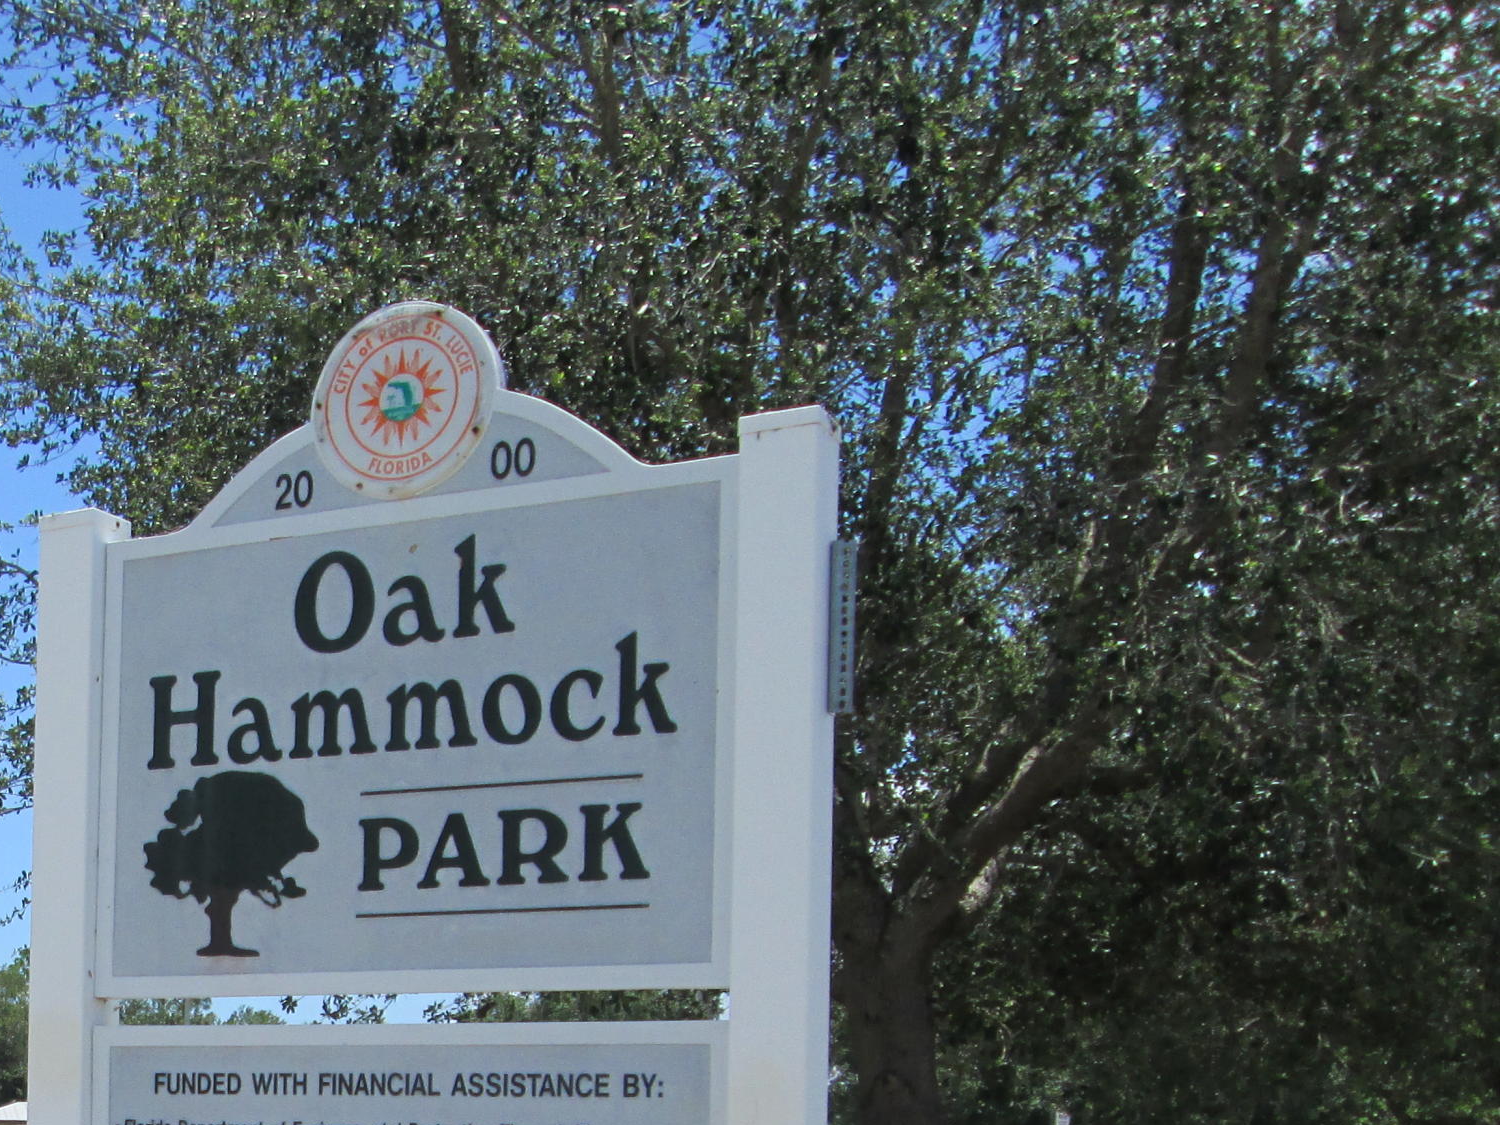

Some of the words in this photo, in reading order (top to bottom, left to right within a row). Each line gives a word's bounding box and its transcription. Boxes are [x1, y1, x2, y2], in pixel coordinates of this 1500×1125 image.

[333, 361, 356, 394] CITY
[359, 338, 374, 356] of
[380, 319, 420, 341] PORT
[424, 321, 441, 340] ST.
[445, 335, 473, 375] LUCIE
[275, 470, 314, 511] 20
[491, 437, 536, 480] 00
[368, 452, 433, 474] FLORIDA
[294, 533, 516, 654] Oak
[146, 631, 678, 770] Hammock
[357, 802, 651, 892] PARK
[154, 1072, 242, 1096] FUNDED
[252, 1072, 308, 1096] WITH
[318, 1072, 441, 1097] FINANCIAL
[451, 1072, 610, 1098] ASSISTANCE
[622, 1073, 665, 1098] BY:
